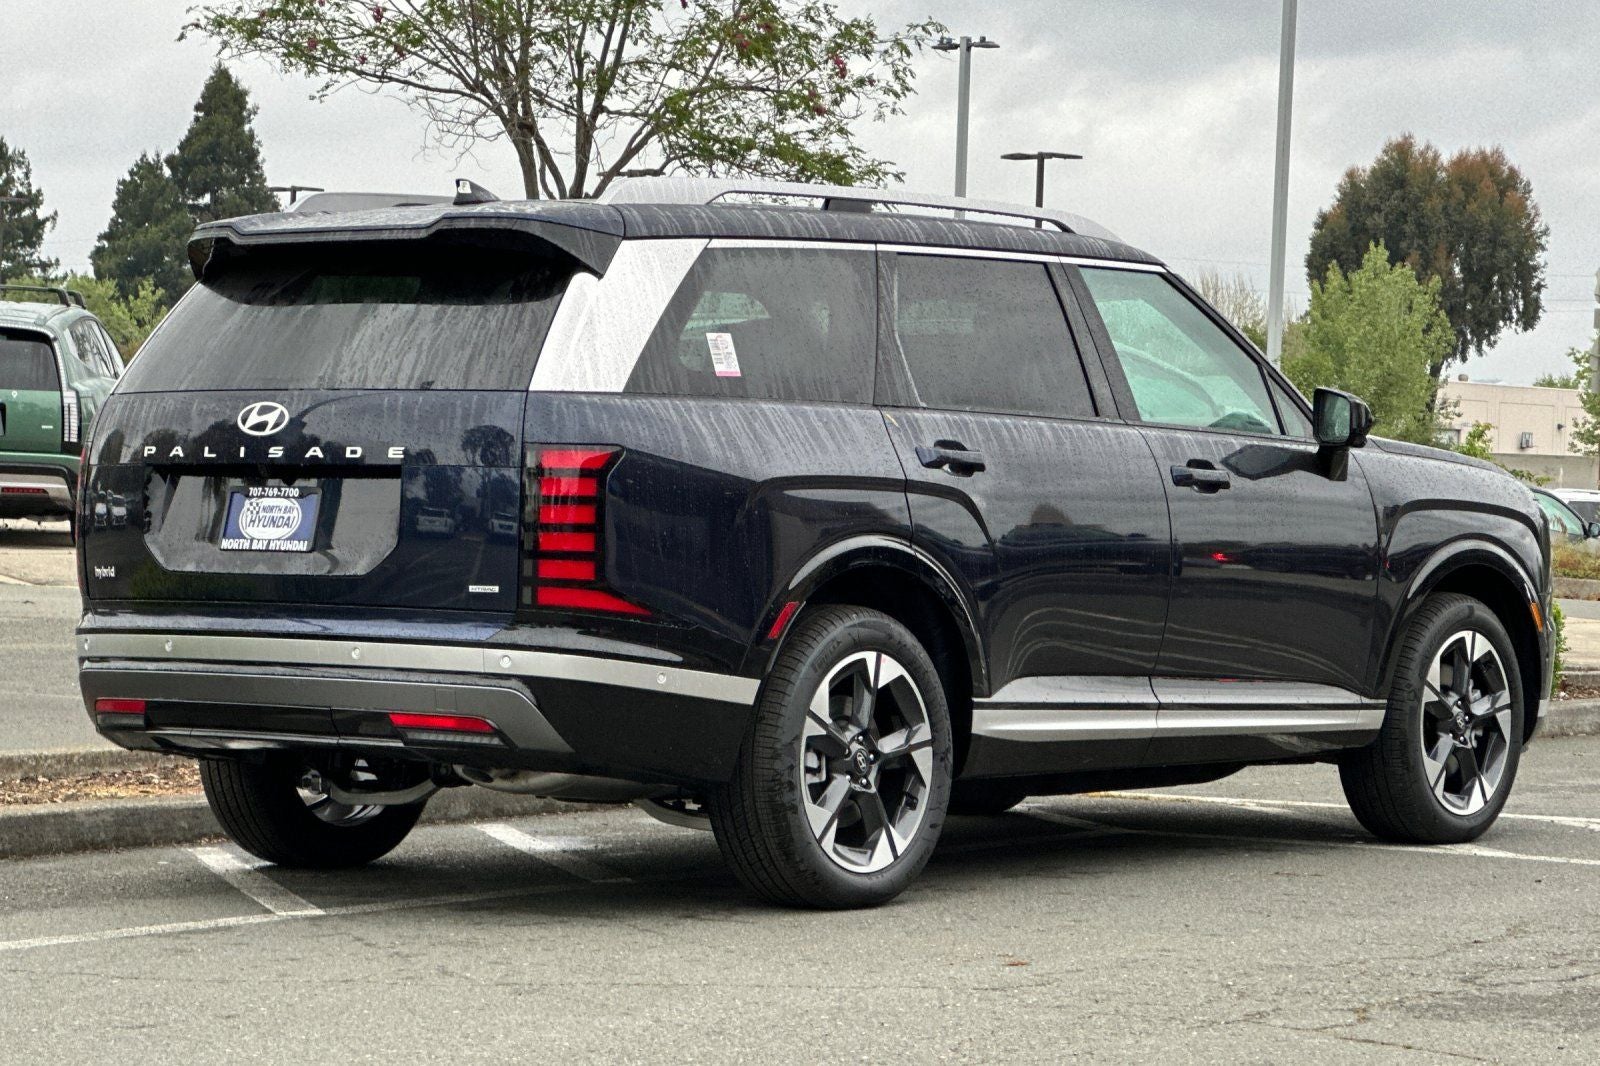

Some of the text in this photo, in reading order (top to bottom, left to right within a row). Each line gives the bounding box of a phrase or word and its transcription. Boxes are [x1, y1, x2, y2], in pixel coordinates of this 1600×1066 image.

[143, 446, 405, 459] PALISADE
[248, 487, 300, 497] 707-769-7700
[261, 505, 295, 514] NORTH BAY
[248, 515, 296, 528] HYUNDAI
[221, 539, 308, 551] NORTH BAY HYUNDAI
